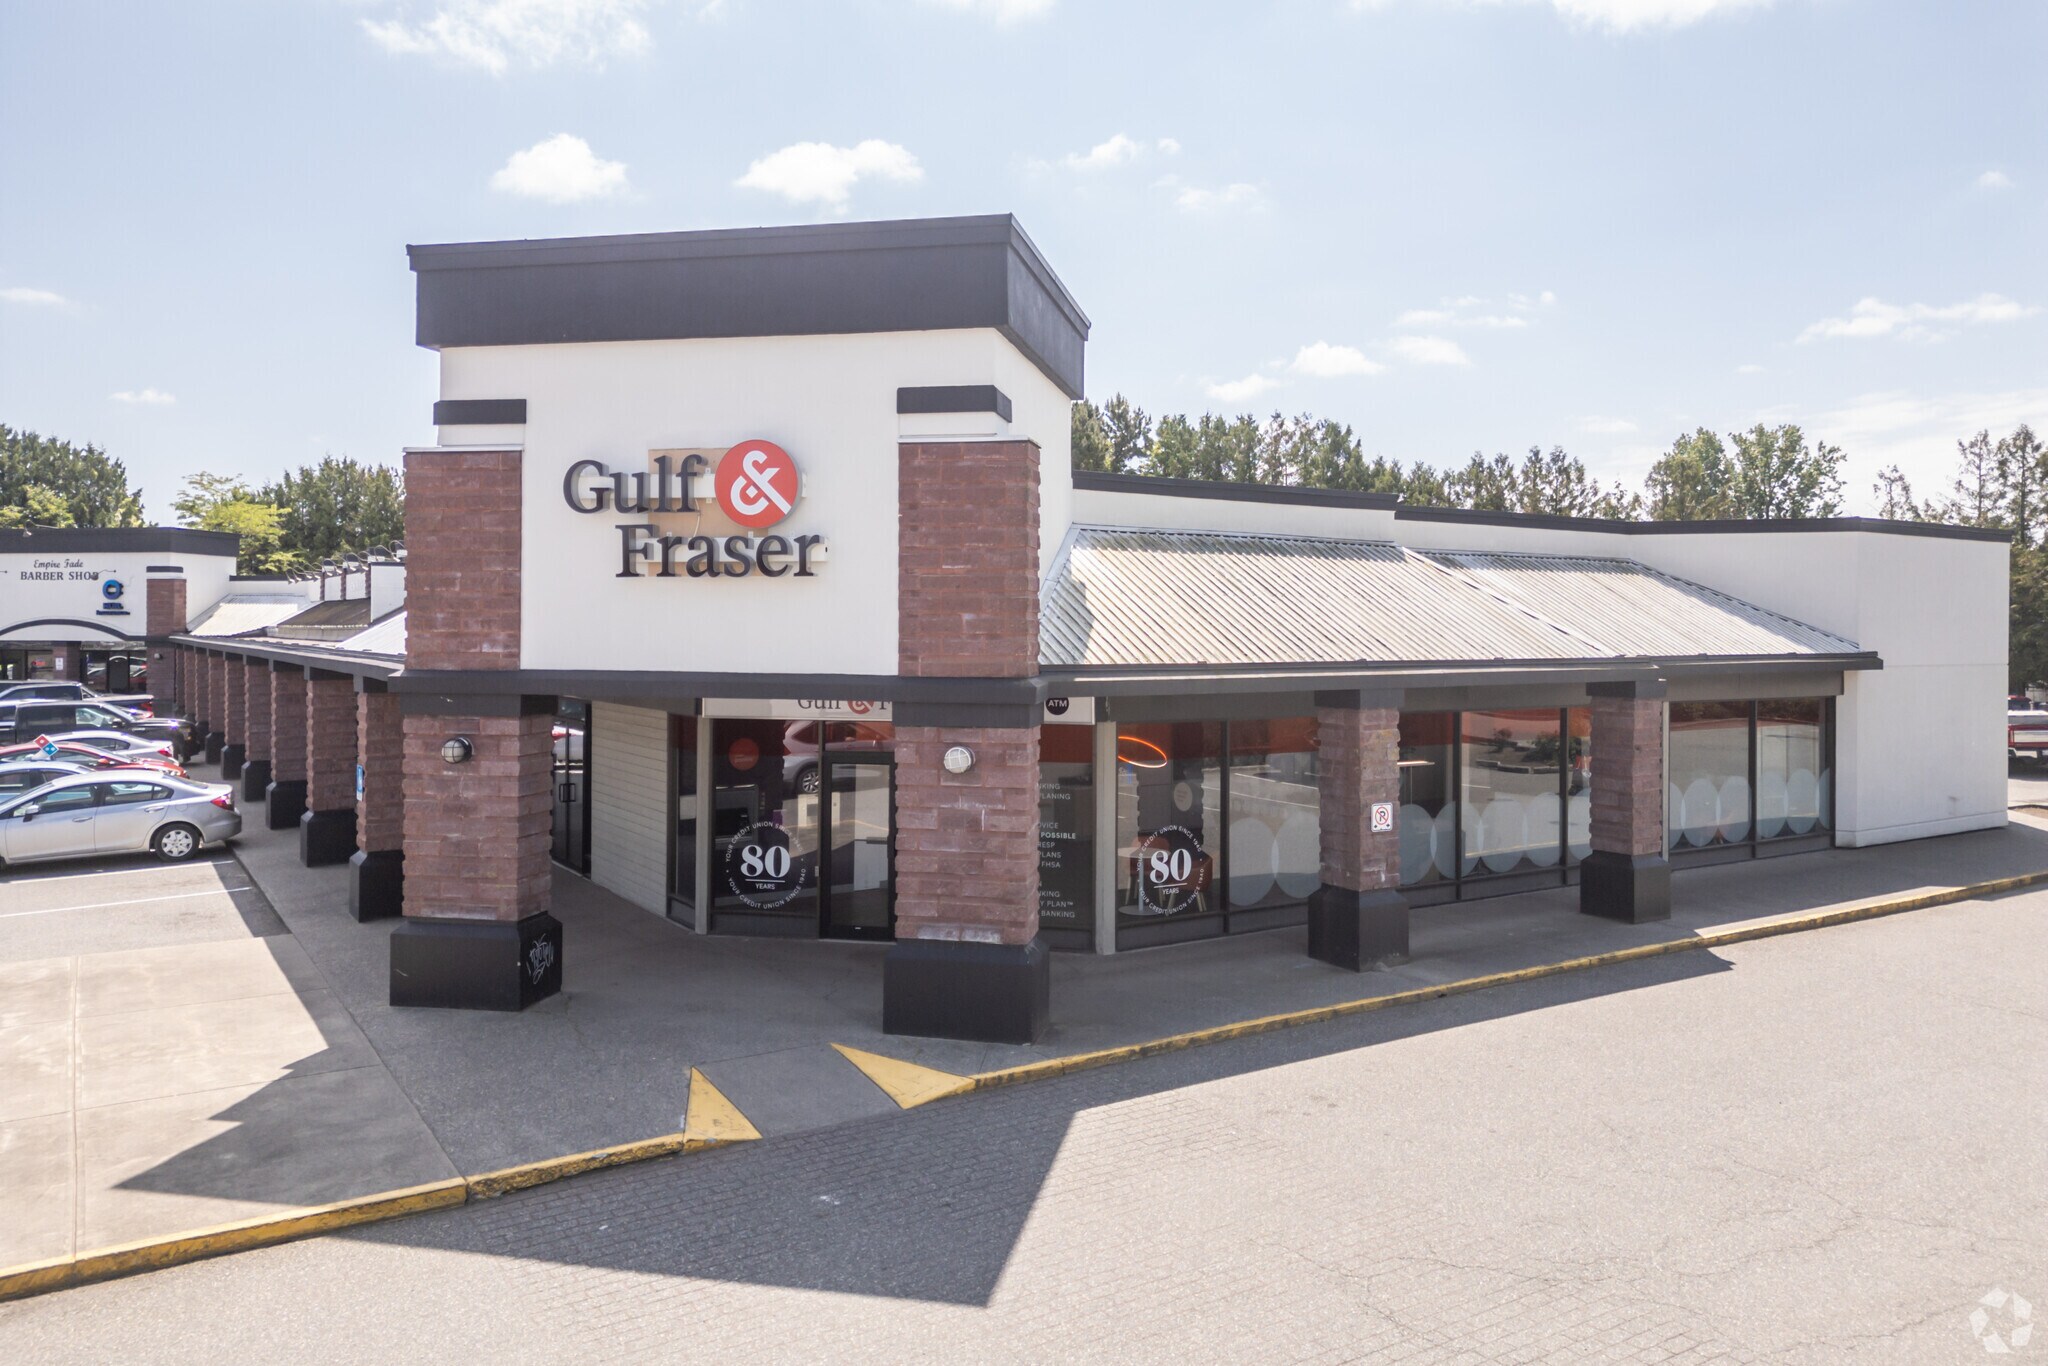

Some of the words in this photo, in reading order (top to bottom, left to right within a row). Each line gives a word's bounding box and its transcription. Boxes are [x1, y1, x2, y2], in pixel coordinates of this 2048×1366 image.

[563, 454, 706, 514] Gulf
[729, 449, 793, 516] &
[615, 524, 823, 578] Fraser
[33, 559, 61, 570] Empire
[64, 558, 84, 568] Fade
[20, 571, 64, 580] BARBER
[1048, 699, 1068, 707] ATM
[1040, 792, 1071, 800] LANING
[725, 844, 734, 862] YOUR
[731, 825, 750, 844] CREDIT
[752, 821, 773, 829] UNION
[1040, 831, 1076, 840] POSSIBLE
[1141, 831, 1159, 852] CREDIT
[1159, 824, 1178, 834] UNION
[1178, 825, 1194, 840] SINCE
[740, 844, 791, 878] 80
[1041, 861, 1061, 869] FHSA
[1149, 848, 1192, 884] 80
[728, 877, 740, 895] YOUR
[739, 894, 761, 909] CREDIT
[762, 900, 785, 910] UNION
[785, 884, 802, 902] SINCE
[1148, 902, 1168, 914] CREDIT
[1168, 903, 1187, 914] UNION
[1187, 886, 1201, 904] SINCE
[1162, 887, 1180, 895] YEARS
[1041, 910, 1075, 919] BANKING
